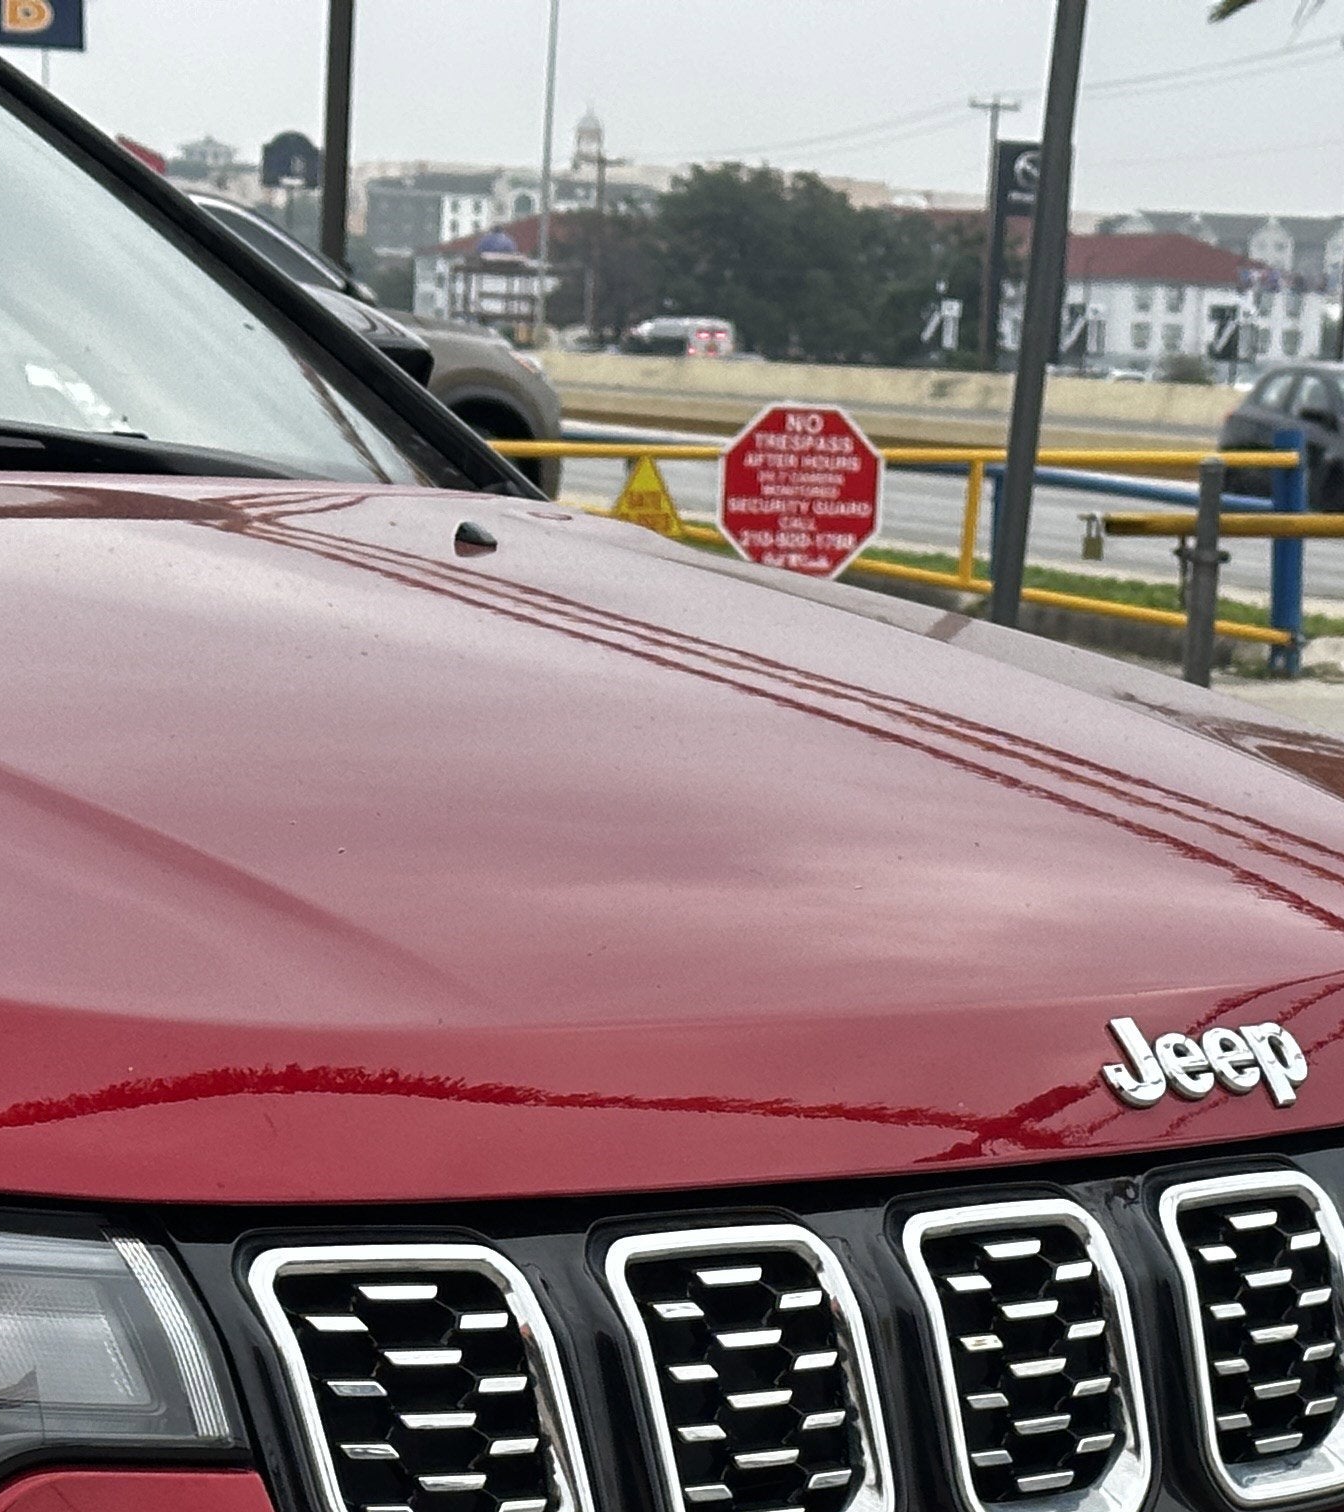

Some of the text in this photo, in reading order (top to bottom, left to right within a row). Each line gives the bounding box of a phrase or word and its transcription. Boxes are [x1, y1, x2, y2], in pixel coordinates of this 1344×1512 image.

[785, 412, 825, 434] NO
[755, 431, 855, 454] TRESPASS
[743, 452, 862, 473] AFTER HOURS
[727, 498, 872, 517] SECURITY GUARD
[778, 516, 817, 530] CALL
[1102, 1017, 1308, 1108] Jeep
